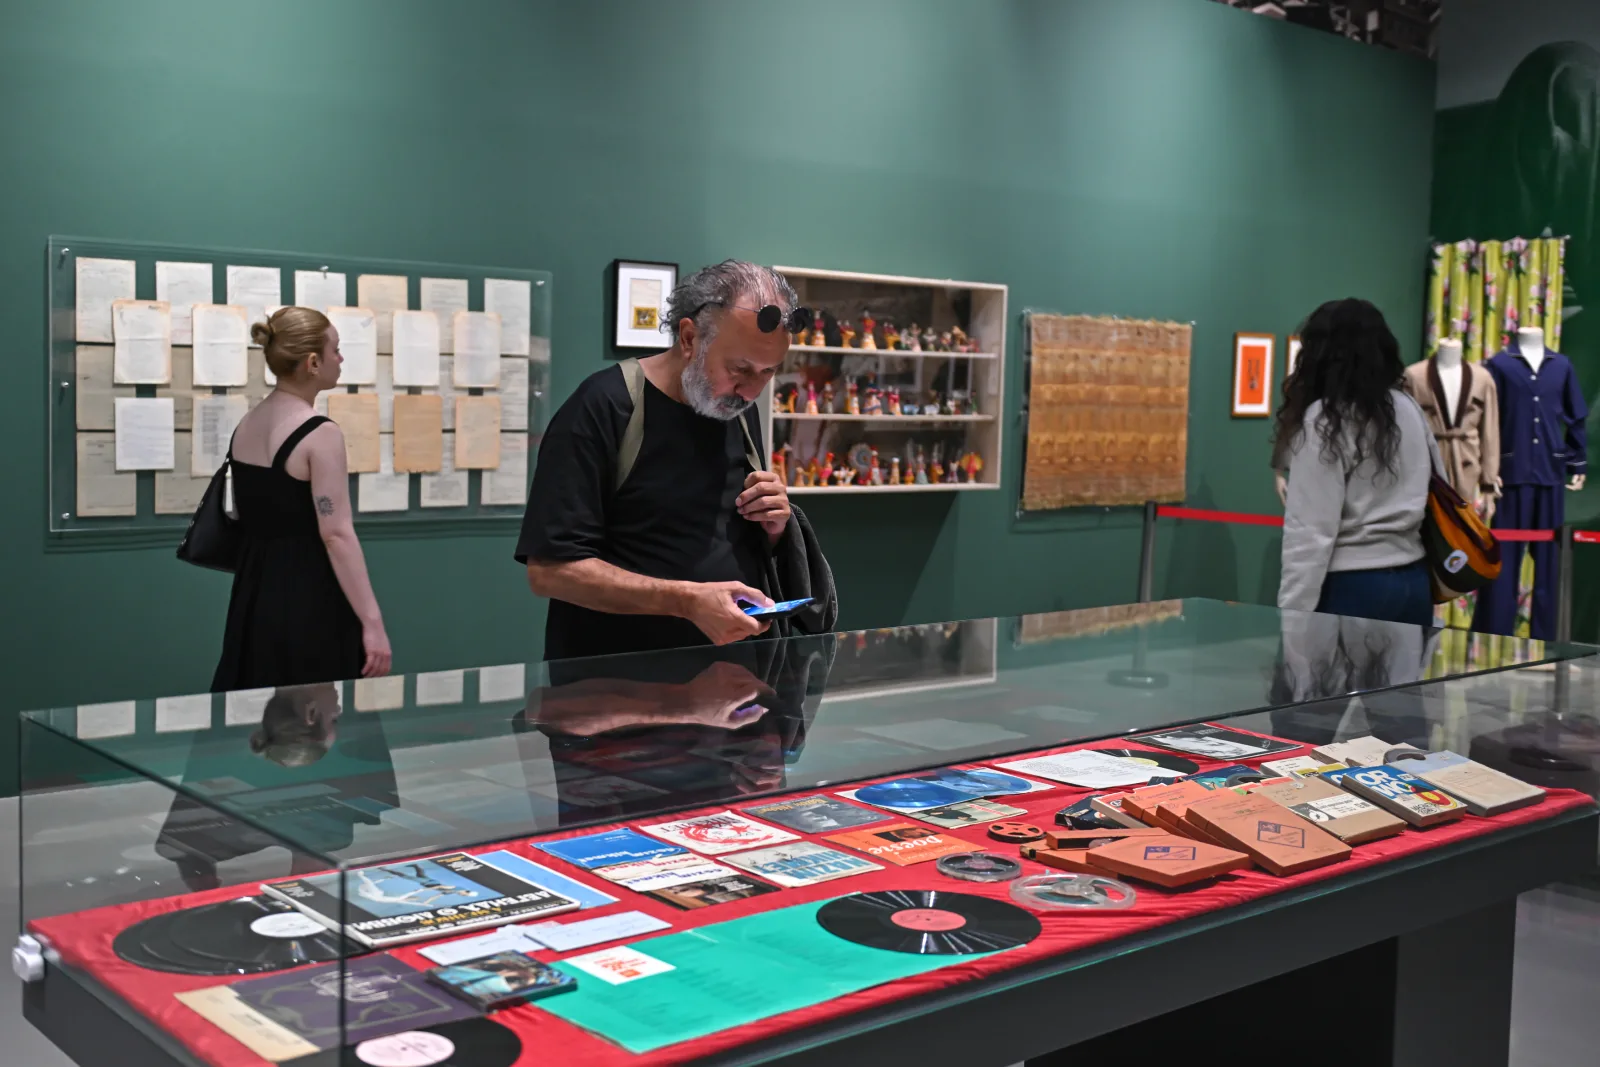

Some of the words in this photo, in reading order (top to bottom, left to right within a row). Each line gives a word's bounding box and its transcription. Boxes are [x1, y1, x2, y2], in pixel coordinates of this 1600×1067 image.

[867, 835, 943, 855] poesie
[752, 849, 846, 875] HIKMET
[784, 855, 871, 880] NAZIM
